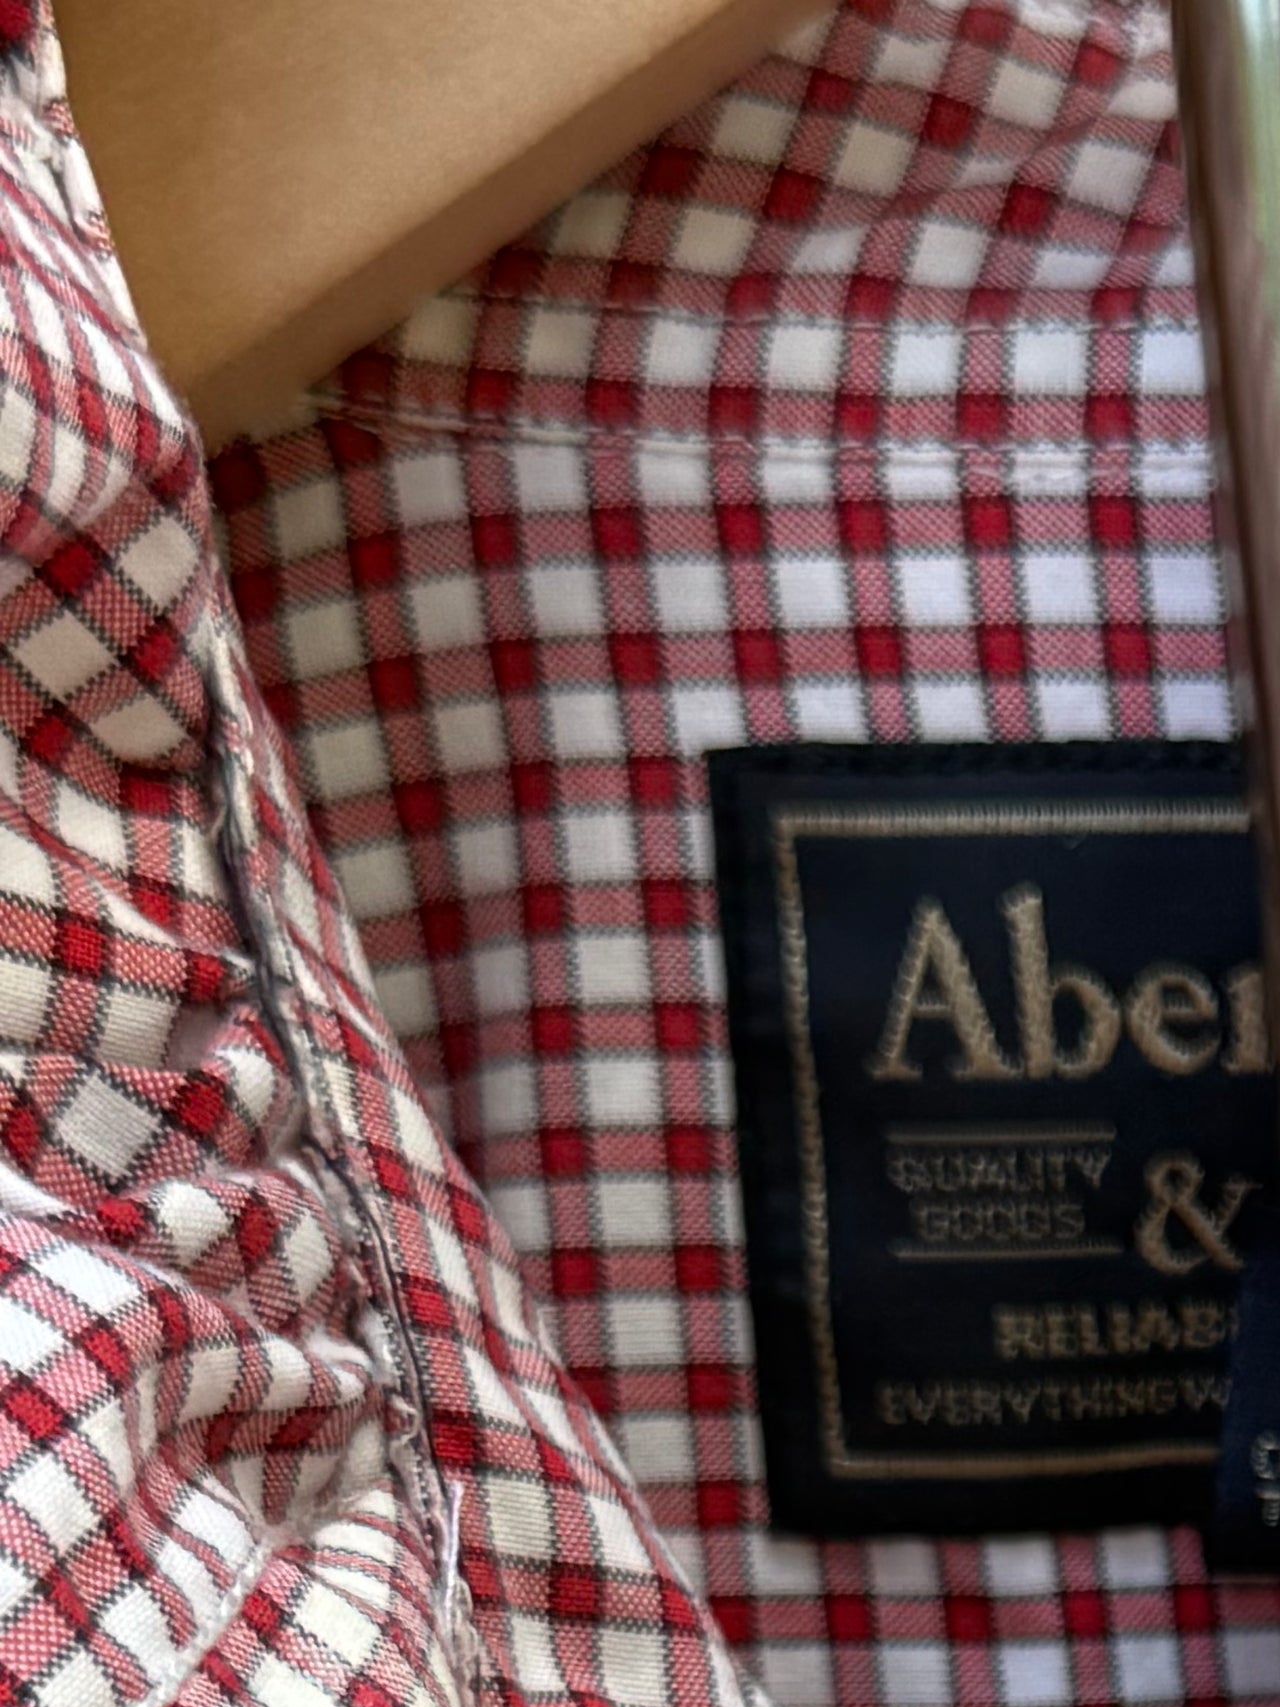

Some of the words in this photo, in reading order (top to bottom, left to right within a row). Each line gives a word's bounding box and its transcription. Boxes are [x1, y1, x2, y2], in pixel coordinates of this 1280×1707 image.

[886, 1146, 1112, 1192] QUALITY
[910, 1196, 1086, 1241] GOODS
[1133, 1149, 1264, 1276] &
[992, 1298, 1240, 1360] RELIAB
[873, 1372, 1178, 1426] EVERYTHING
